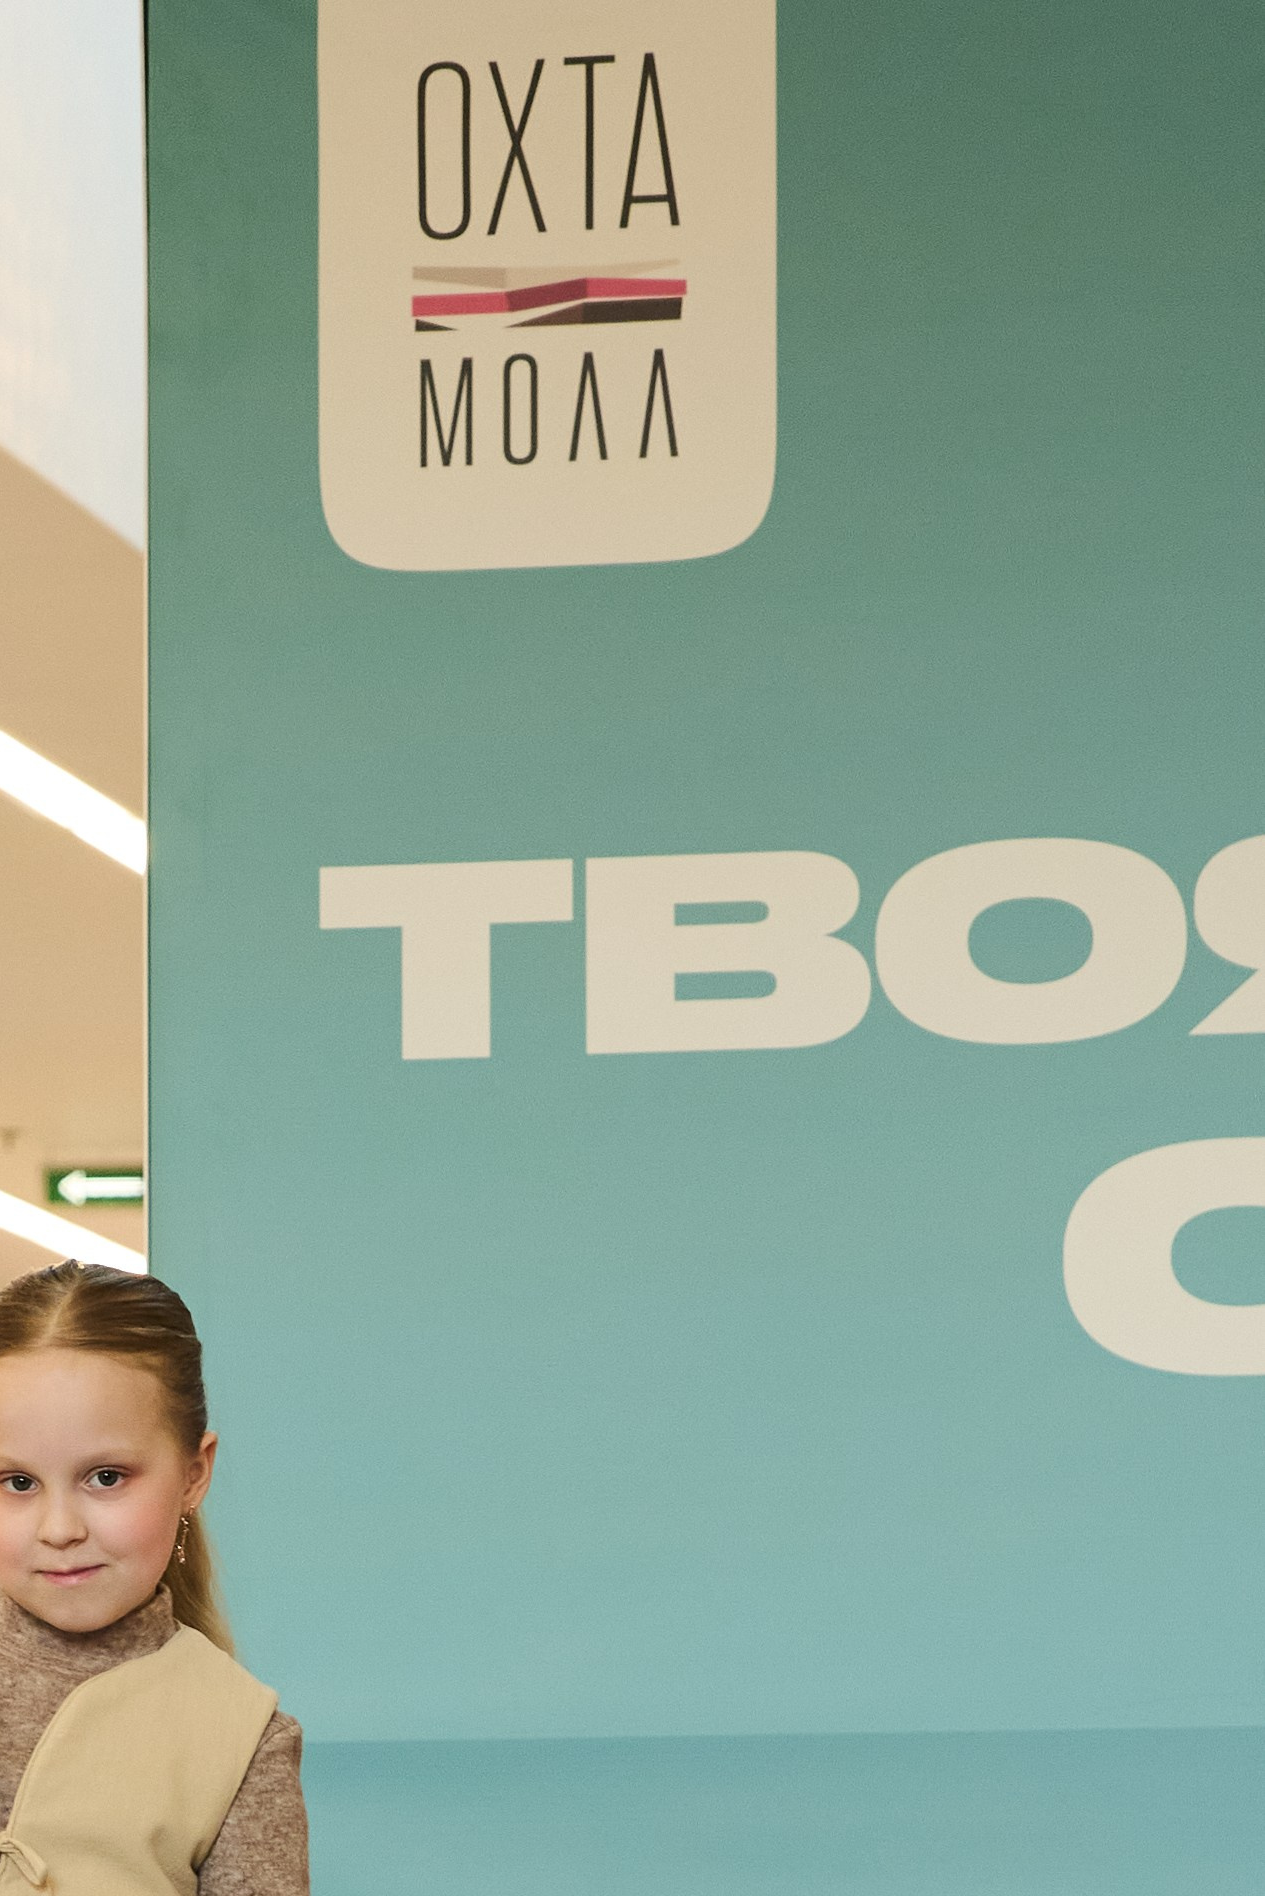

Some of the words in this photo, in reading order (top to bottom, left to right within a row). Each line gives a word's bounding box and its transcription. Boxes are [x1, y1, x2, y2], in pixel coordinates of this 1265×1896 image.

[416, 52, 680, 241] ОХТА
[419, 348, 679, 468] МОЛЛ
[319, 834, 1265, 1061] ТВО
